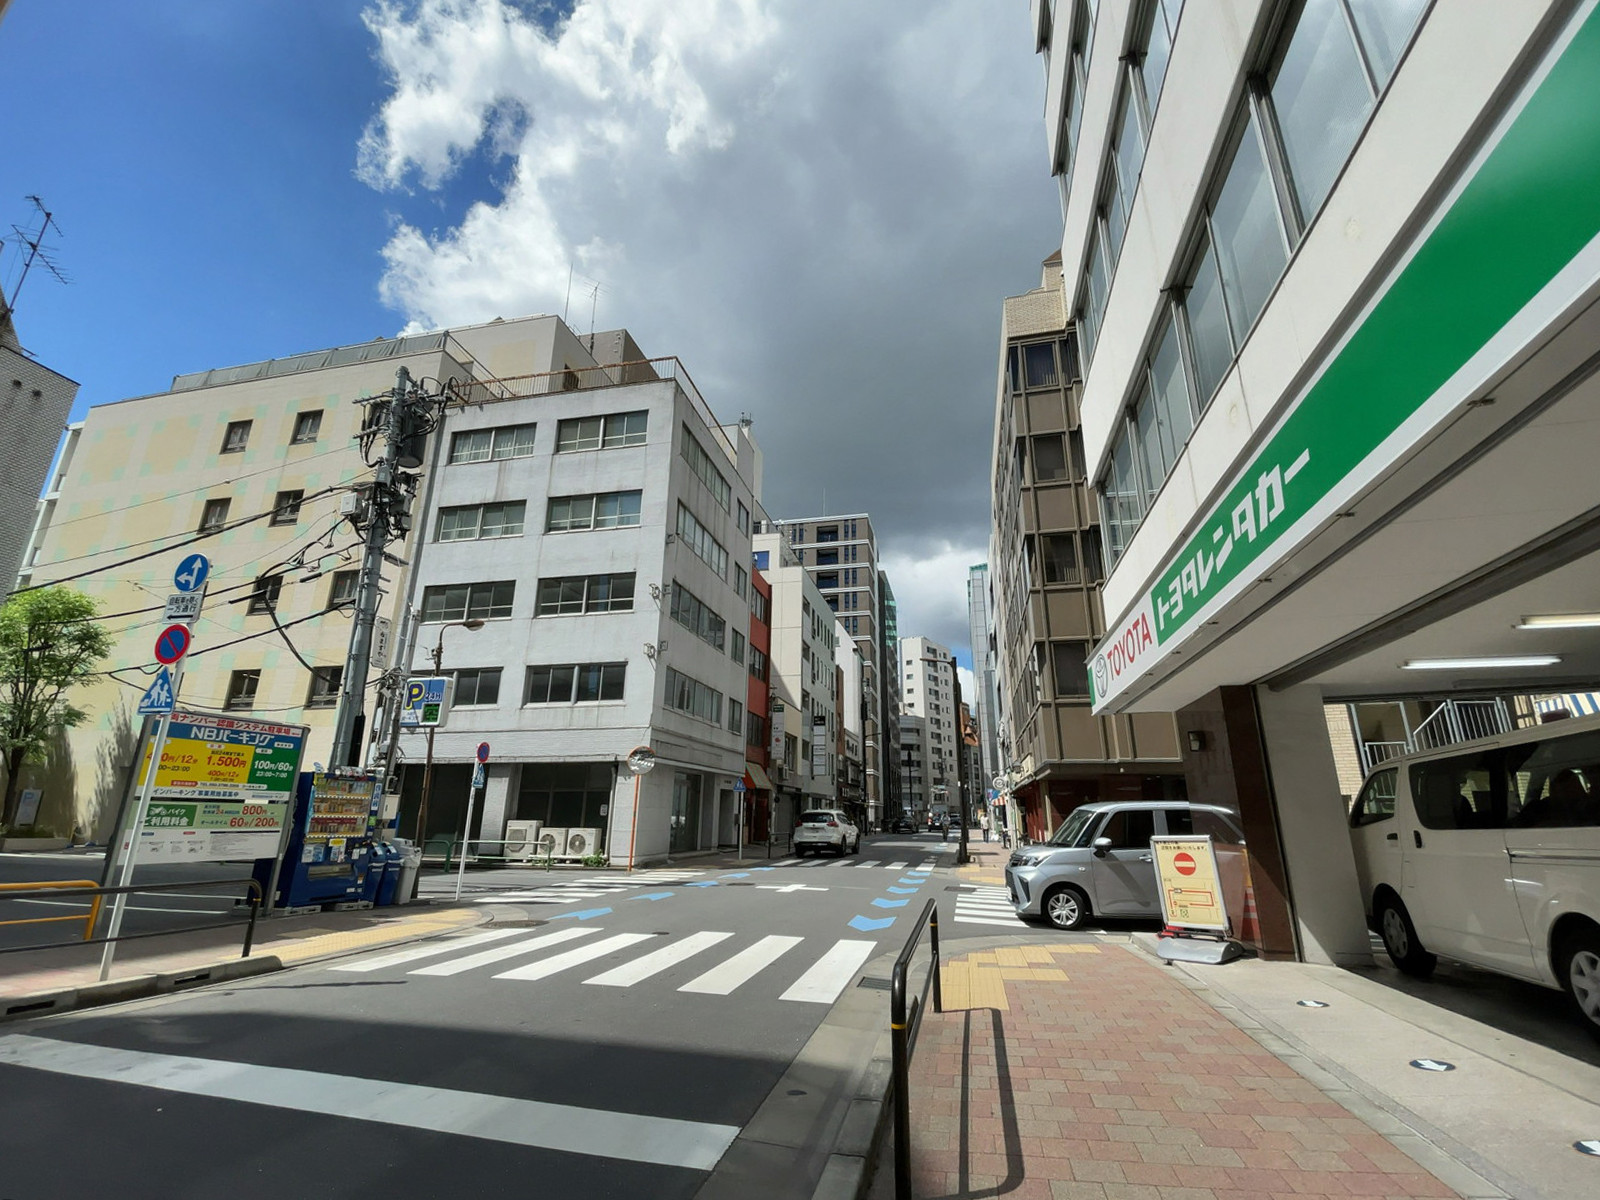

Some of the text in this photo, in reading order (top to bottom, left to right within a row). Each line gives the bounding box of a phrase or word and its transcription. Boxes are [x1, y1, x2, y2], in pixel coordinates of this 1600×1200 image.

[1156, 448, 1310, 631] トヨタレンタカー
[167, 604, 197, 613] 一方通行
[169, 596, 199, 606] 自転車を除く
[1106, 612, 1153, 681] TOYOTA
[404, 681, 425, 710] P
[157, 712, 291, 736] 両ナンバー認識システム駐車場
[191, 725, 275, 746] NBパーキング
[147, 751, 198, 764] 40円/12分
[254, 760, 294, 772] 100円/60分
[167, 808, 186, 816] バイク
